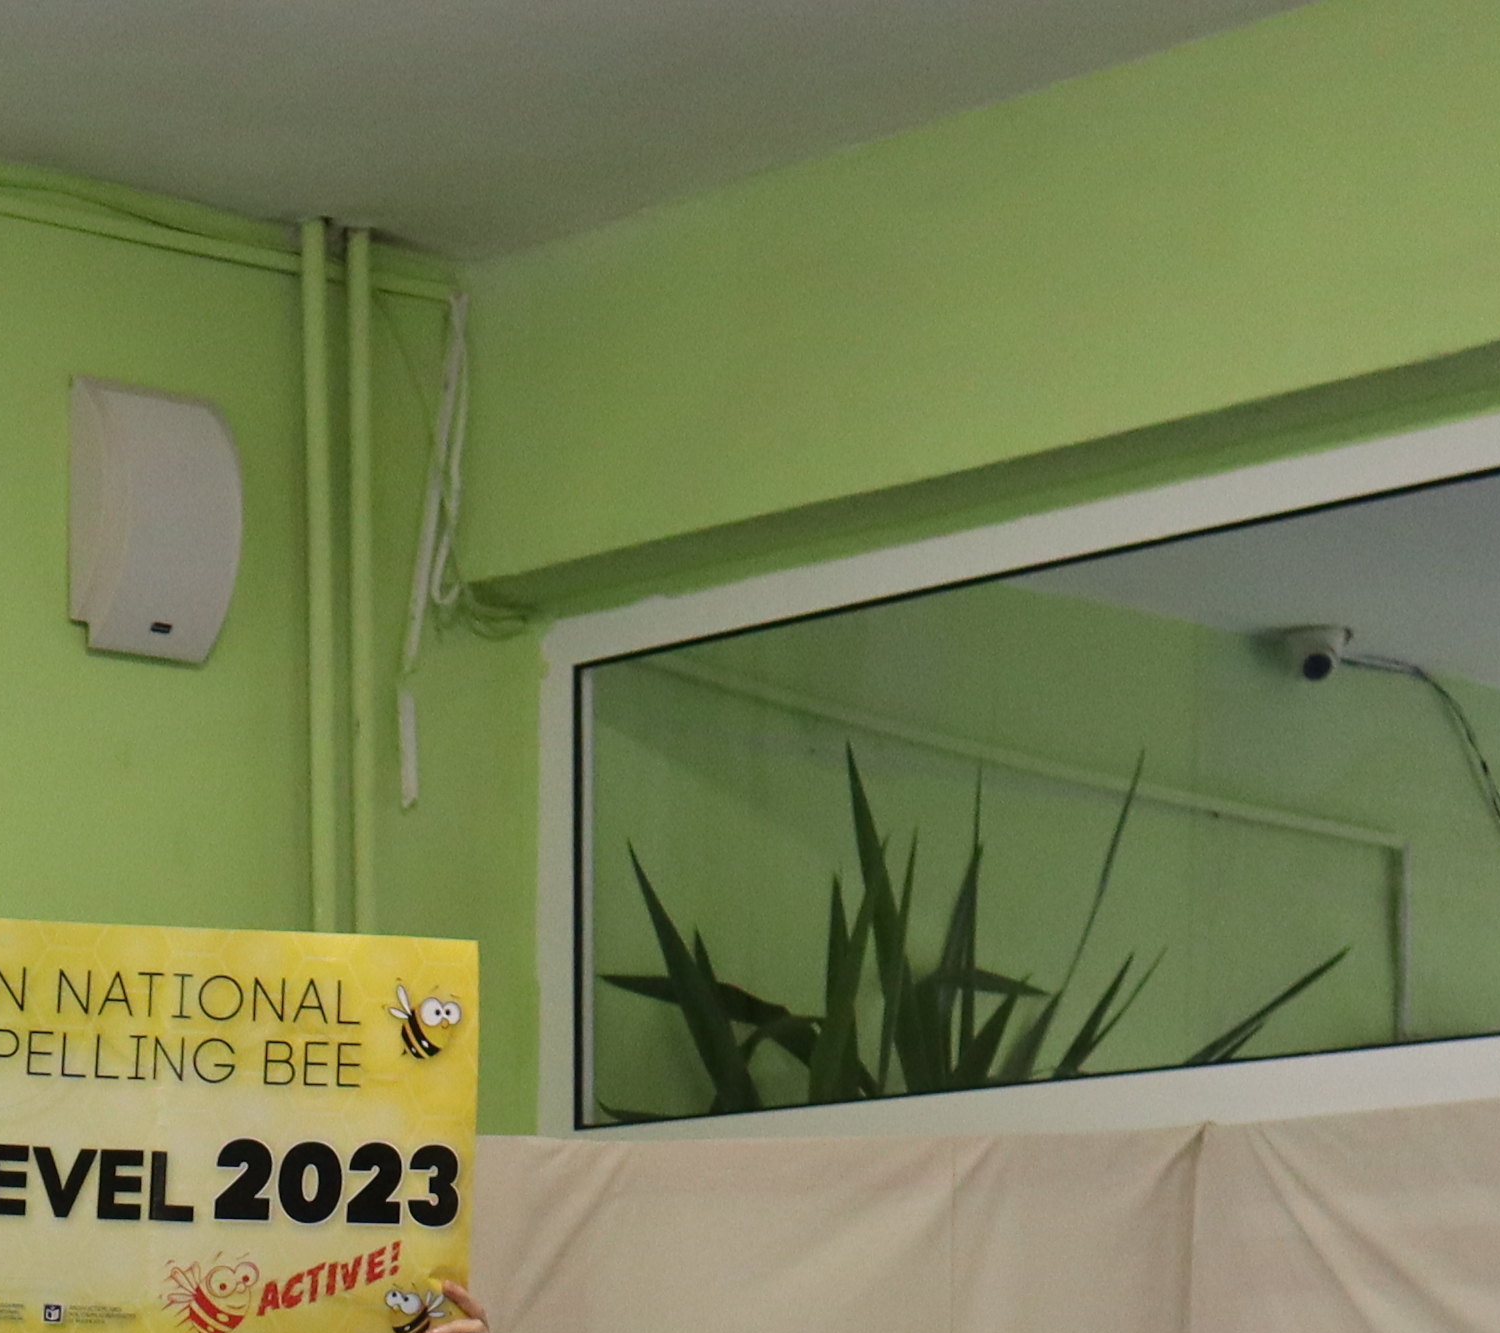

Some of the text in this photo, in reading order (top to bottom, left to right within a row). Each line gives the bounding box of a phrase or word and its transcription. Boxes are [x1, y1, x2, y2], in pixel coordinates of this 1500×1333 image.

[56, 968, 361, 1025] NATIONAL
[263, 1039, 361, 1087] BEE
[213, 1138, 461, 1228] 2023
[256, 1241, 402, 1317] ACTIVE!
